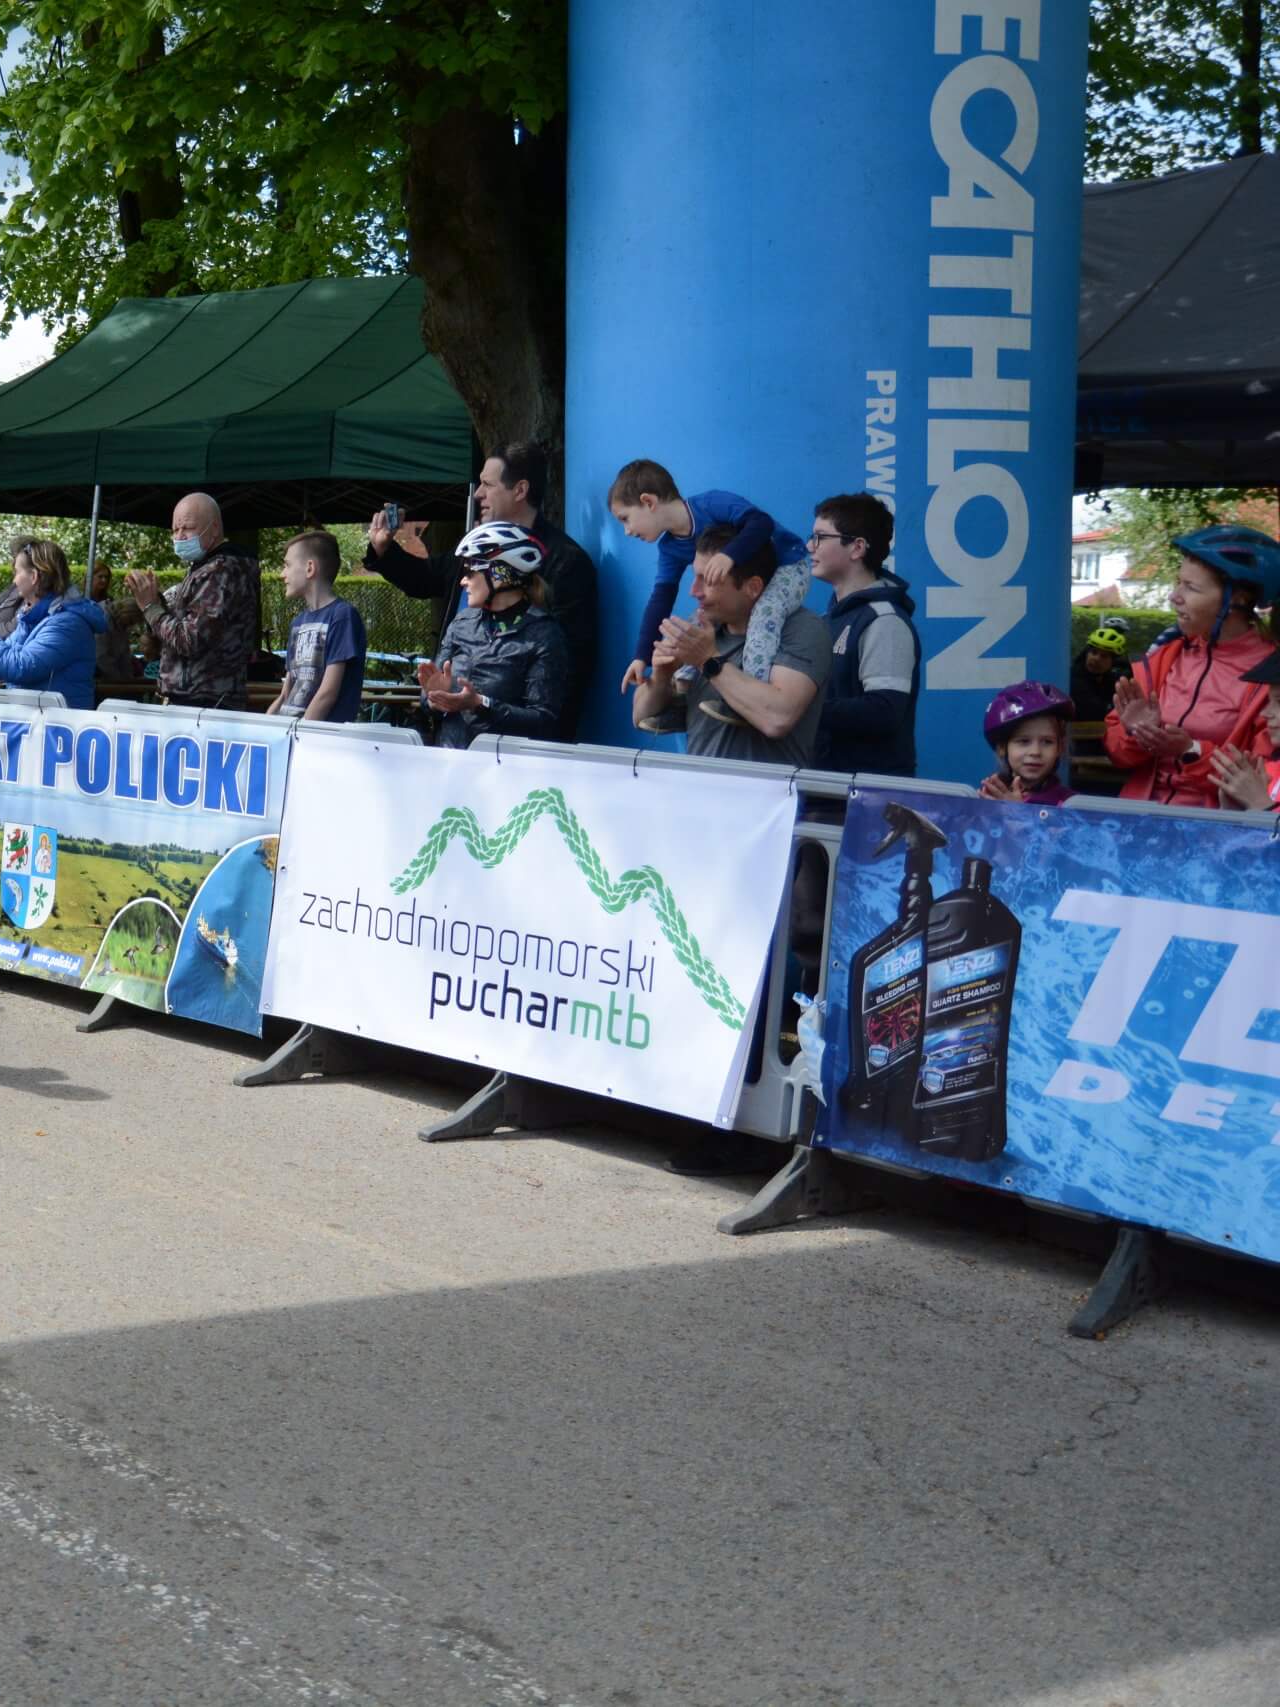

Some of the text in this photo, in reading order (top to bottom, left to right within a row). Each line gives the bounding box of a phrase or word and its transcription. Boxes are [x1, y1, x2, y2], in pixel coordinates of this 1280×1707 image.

[40, 723, 270, 819] POLICKI
[299, 887, 657, 994] zachodniopomorski
[429, 968, 652, 1051] pucharmtb
[931, 994, 962, 1010] QUARTZ
[962, 981, 1002, 1001] SHAMPOO
